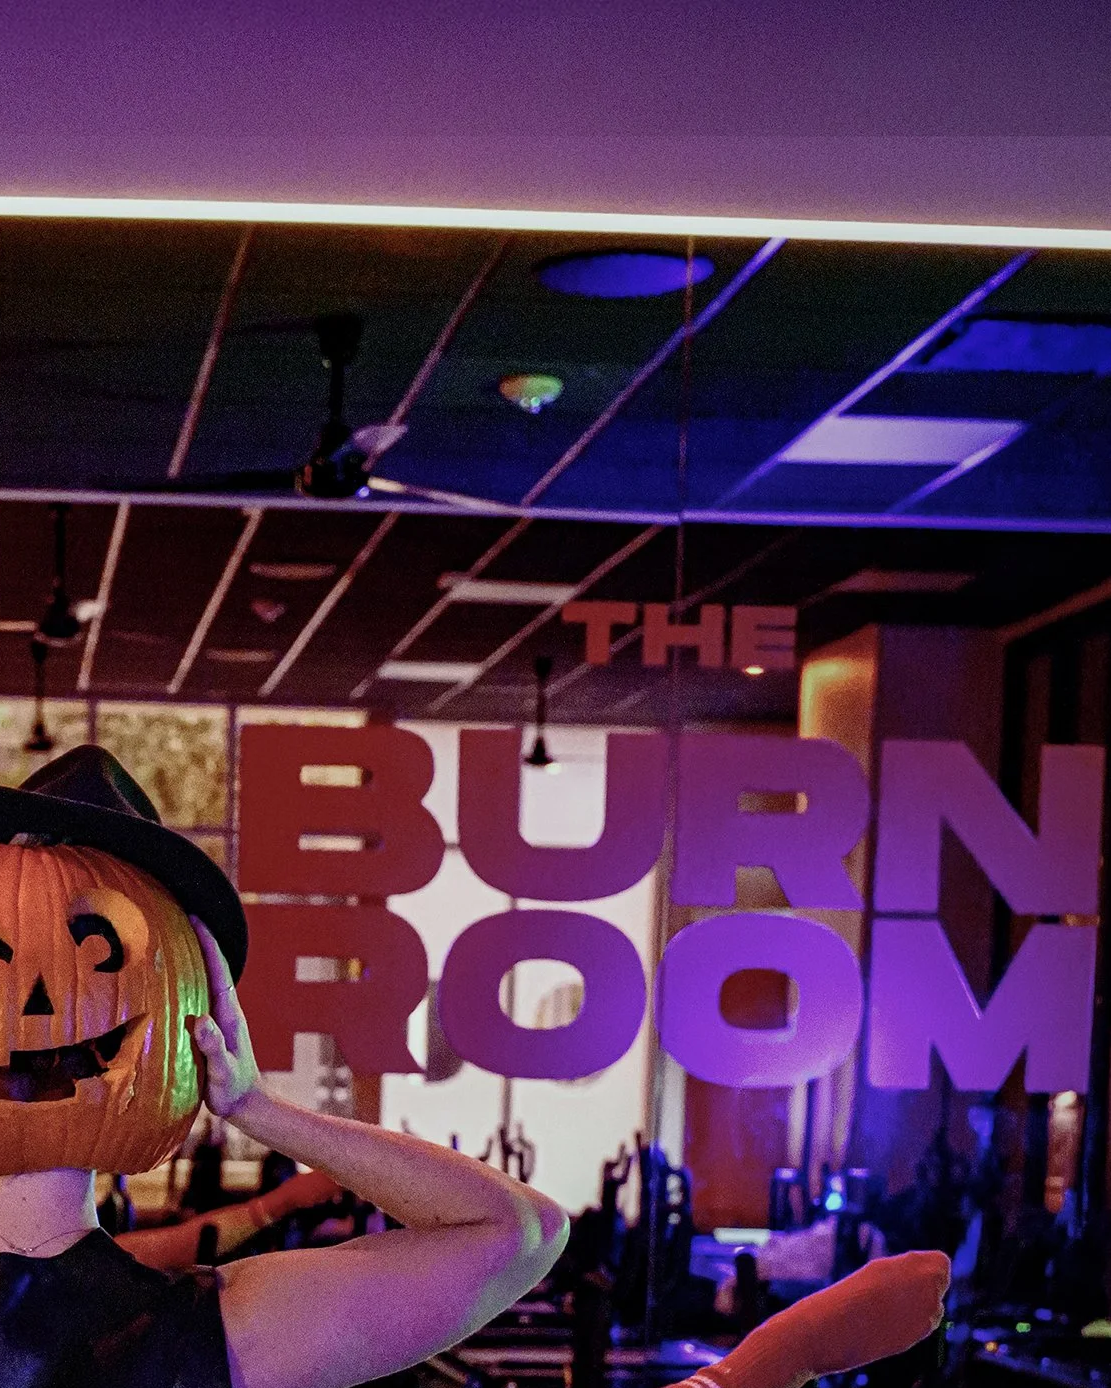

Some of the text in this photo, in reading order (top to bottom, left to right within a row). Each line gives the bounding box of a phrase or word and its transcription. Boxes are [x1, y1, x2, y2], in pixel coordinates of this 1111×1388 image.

[561, 600, 799, 669] THE
[239, 725, 1105, 916] BURN
[240, 903, 1098, 1094] ROOM
